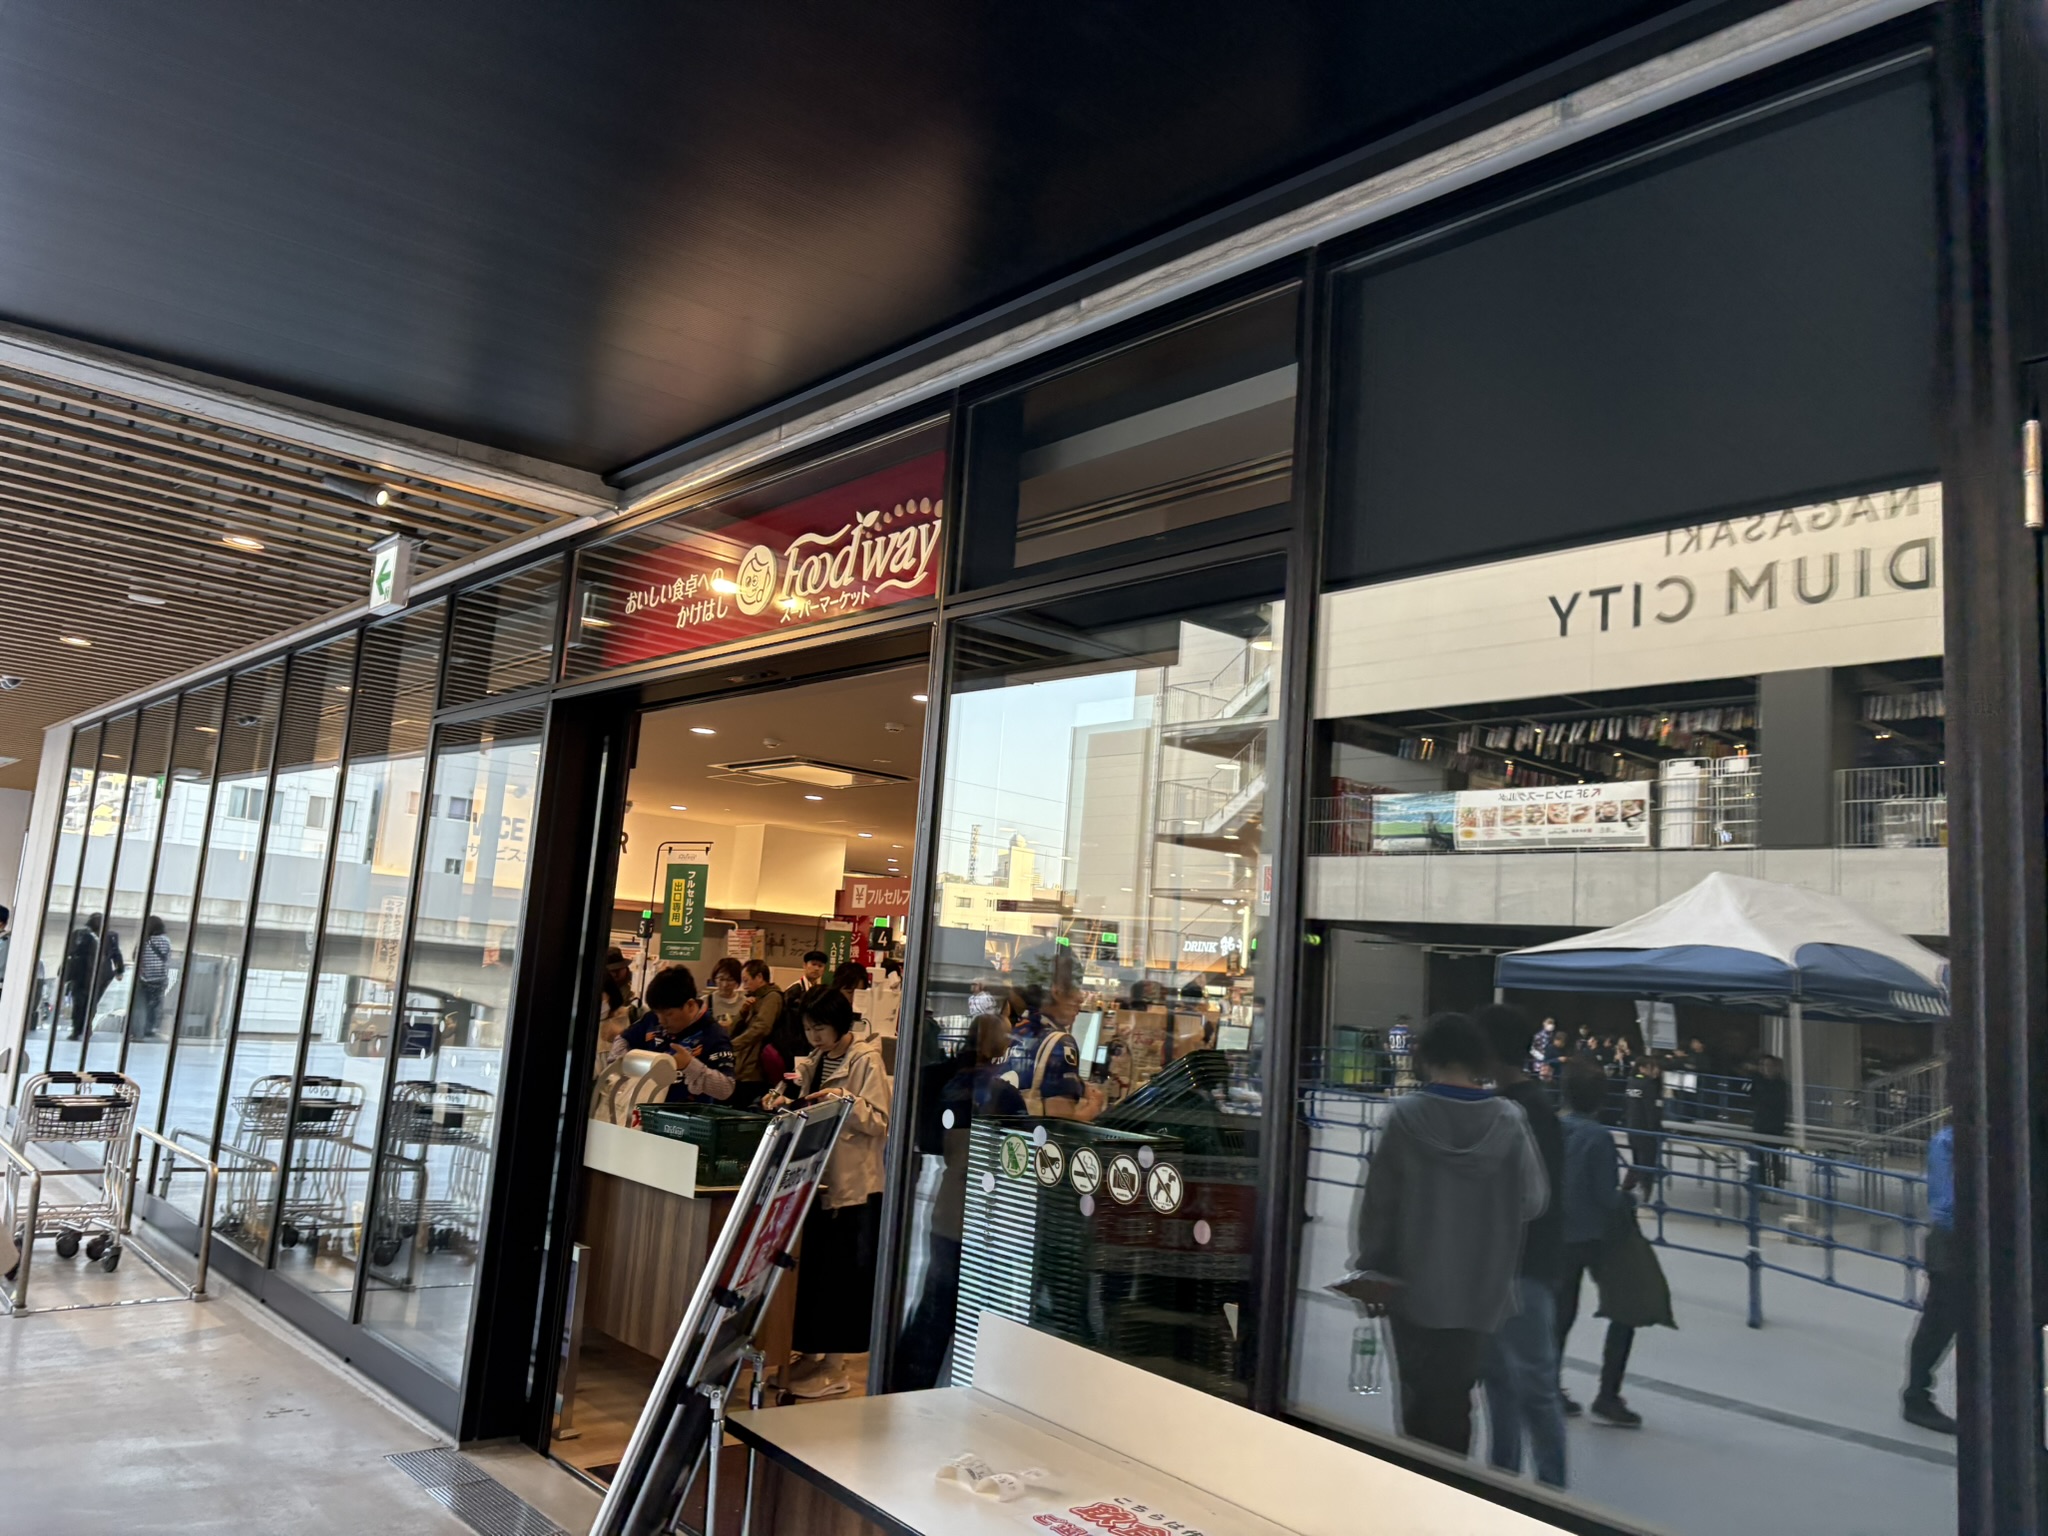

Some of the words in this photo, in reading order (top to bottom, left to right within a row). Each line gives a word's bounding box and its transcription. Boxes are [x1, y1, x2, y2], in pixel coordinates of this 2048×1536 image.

[779, 518, 942, 601] Foodway
[676, 595, 729, 629] かけはし
[779, 585, 871, 624] スーパーマーケット
[467, 842, 527, 863] サビス
[671, 881, 684, 923] 出口専用
[683, 870, 697, 935] フルセルフレジ
[867, 888, 911, 906] フルセルフ
[838, 935, 846, 964] フルセル
[877, 930, 888, 947] 4
[1182, 940, 1219, 954] DRINK
